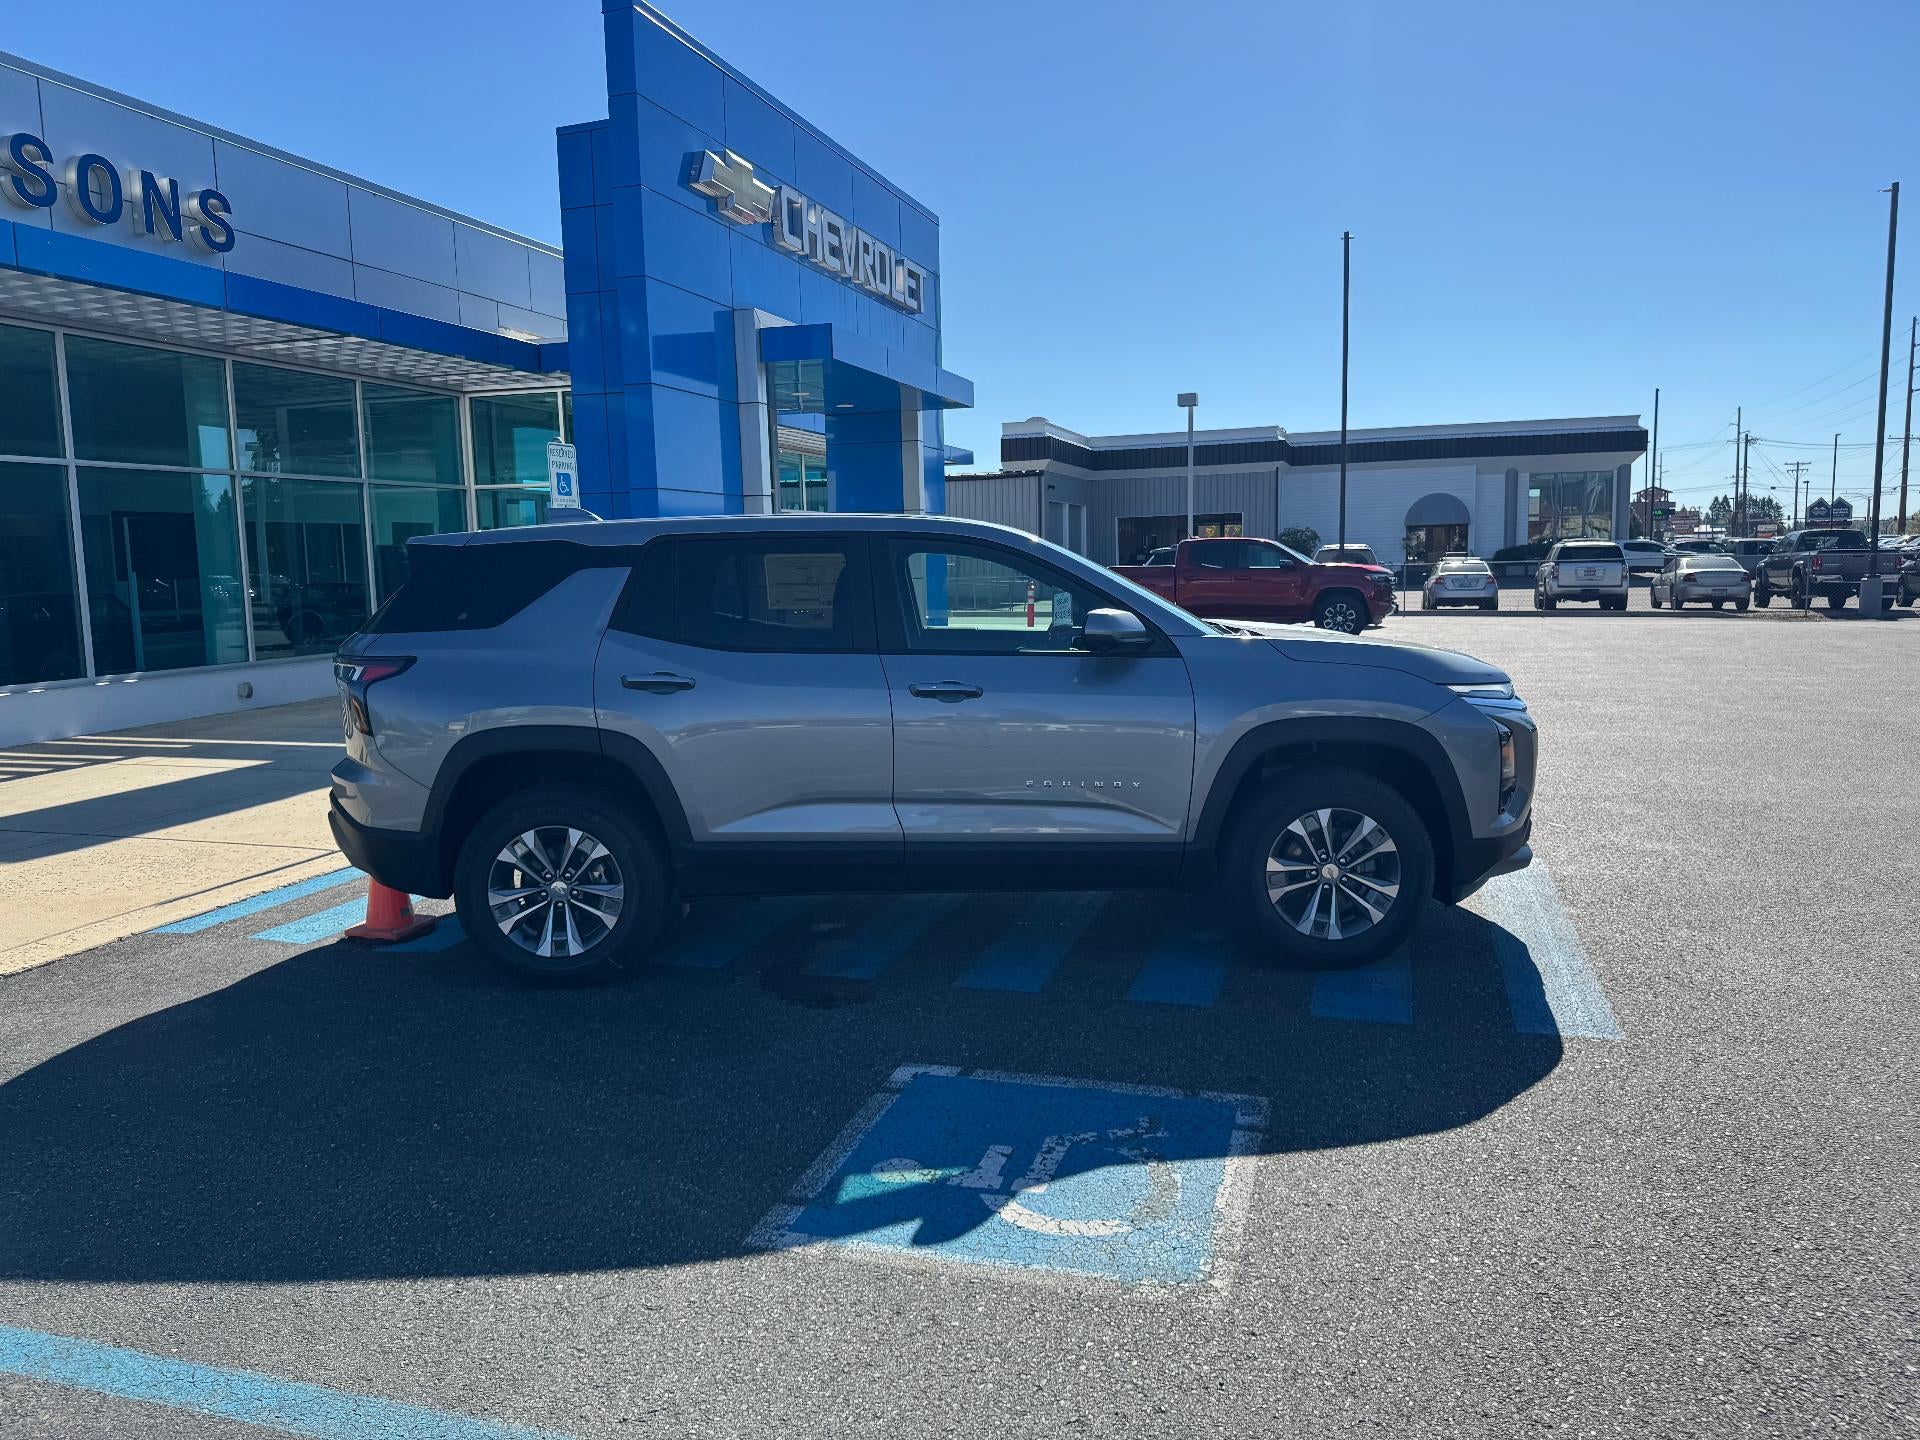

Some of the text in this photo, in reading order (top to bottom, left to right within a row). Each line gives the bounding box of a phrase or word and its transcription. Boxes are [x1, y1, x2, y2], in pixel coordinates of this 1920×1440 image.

[5, 132, 236, 253] SONS
[773, 185, 927, 314] CHEVROLET
[550, 447, 574, 459] RESERVED
[551, 460, 574, 471] PARKING
[1025, 779, 1141, 788] EQUINOX
